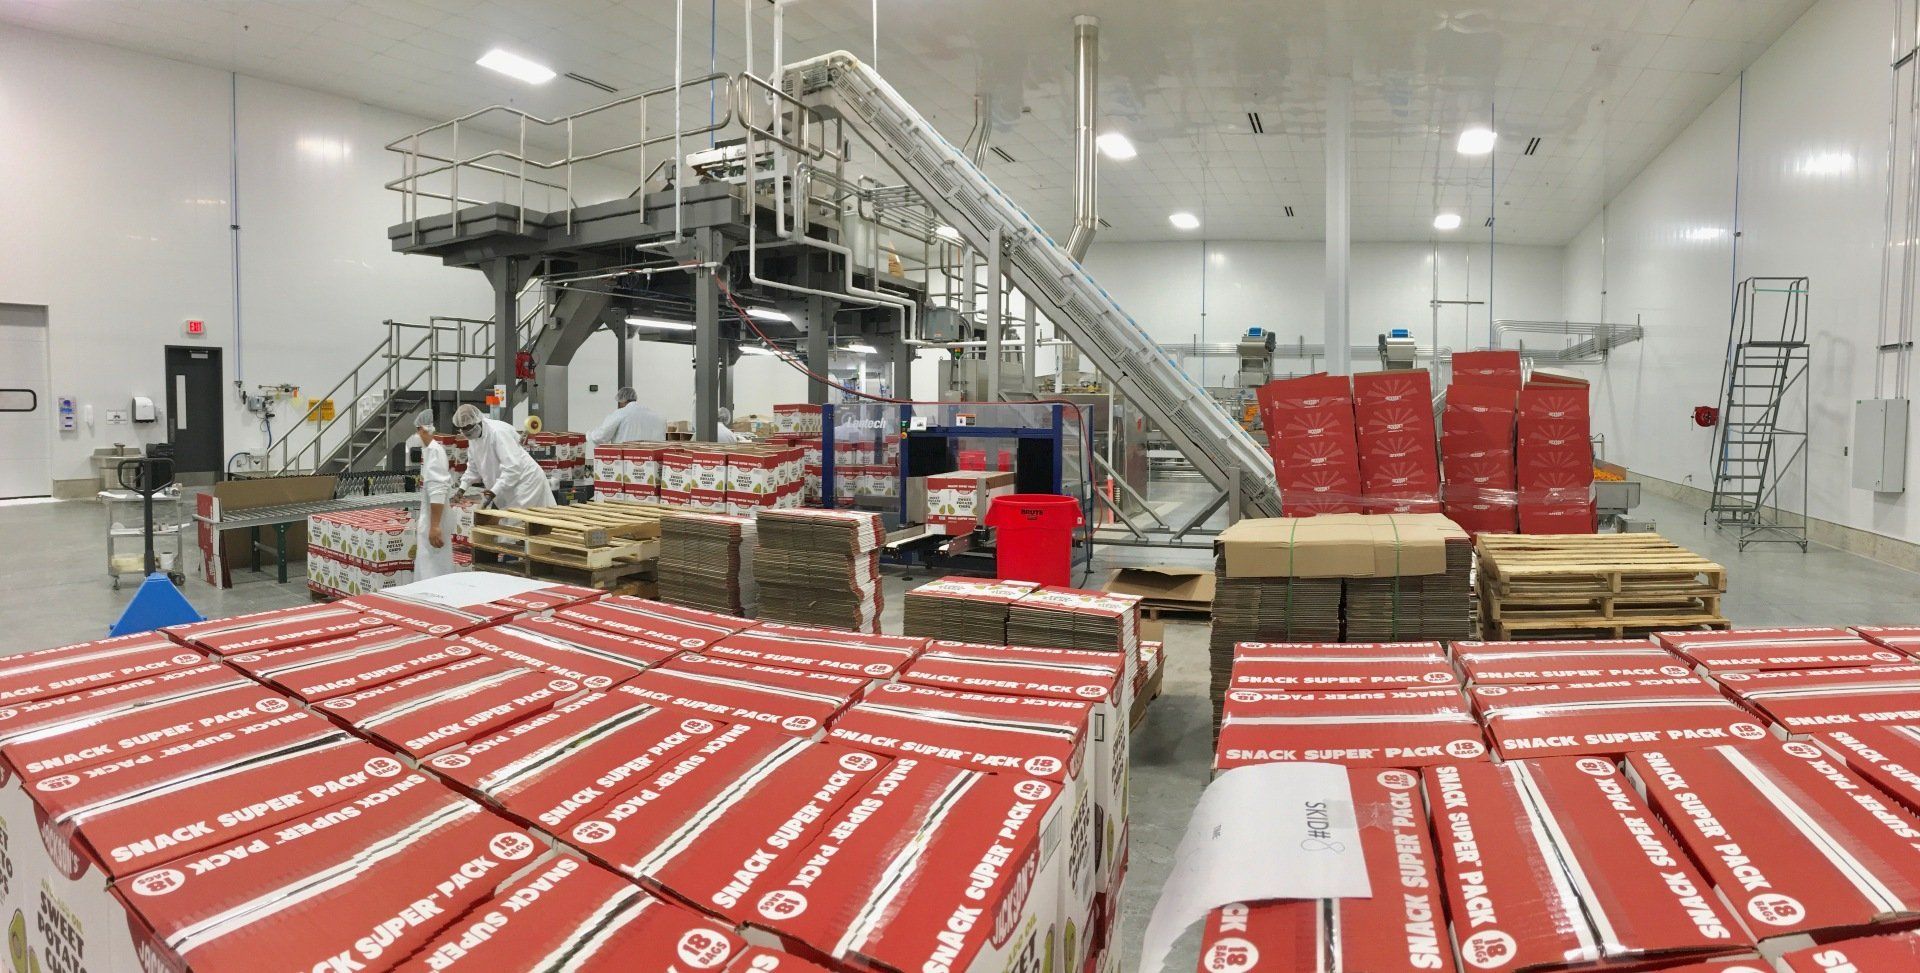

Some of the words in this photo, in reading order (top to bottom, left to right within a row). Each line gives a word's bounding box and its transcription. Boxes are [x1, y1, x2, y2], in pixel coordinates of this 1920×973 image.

[560, 610, 602, 623] SNACK
[645, 630, 682, 642] PACK
[121, 660, 171, 675] PACK
[460, 636, 502, 654] SNACK
[547, 665, 588, 680] PACK
[711, 646, 762, 658] SNACK
[818, 659, 862, 670] PACK
[1705, 658, 1766, 666] SNACK
[158, 665, 222, 681] SNACK
[300, 677, 358, 694] SNACK
[408, 652, 447, 666] PACK
[907, 671, 961, 682] SNACK
[1025, 683, 1072, 693] PACK
[1238, 676, 1298, 684] SNACK
[1371, 675, 1421, 683] PACK
[1475, 671, 1539, 679] SNACK
[23, 695, 82, 712] PACK
[556, 692, 608, 714] SNACK
[617, 685, 675, 702] SNACK
[732, 708, 783, 724] PACK
[1262, 693, 1320, 701] PACK
[1392, 690, 1457, 699] SNACK
[238, 712, 309, 734] SNACK
[405, 722, 469, 750] SNACK
[513, 688, 554, 706] PACK
[26, 744, 114, 773] SNACK
[199, 707, 257, 727] PACK
[465, 735, 511, 756] PACK
[699, 723, 751, 754] SNACK
[829, 728, 900, 748] SNACK
[971, 752, 1023, 768] PACK
[1454, 742, 1475, 750] 18
[1503, 735, 1580, 750] SNACK
[1666, 727, 1730, 740] PACK
[1828, 731, 1890, 764] SNACK
[367, 759, 391, 769] 18
[844, 755, 864, 767] 18
[857, 757, 874, 770] BAGS
[1226, 749, 1297, 761] SNACK
[1385, 745, 1445, 758] PACK
[82, 755, 154, 778] PACK
[375, 764, 399, 775] BAGS
[871, 758, 918, 797] SNACK
[1807, 760, 1860, 791] PACK
[539, 786, 604, 826] SNACK
[647, 732, 691, 763] PACK
[354, 774, 427, 808] SNACK
[1595, 778, 1636, 811] PACK
[110, 820, 215, 862] SNACK
[307, 771, 369, 798] PACK
[604, 789, 661, 822] PACK
[1389, 792, 1416, 828] PACK
[576, 822, 600, 835] BAGS
[1305, 801, 1331, 838] SKID#
[1642, 751, 1689, 791] SNACK
[1714, 844, 1772, 892] PACK
[494, 836, 518, 850] 18
[586, 828, 609, 839] 18
[712, 848, 778, 909] SNACK
[814, 769, 856, 802] PACK
[185, 839, 270, 876] PACK
[503, 841, 530, 858] BAGS
[1436, 766, 1468, 809] SNACK
[1459, 871, 1497, 928] PACK
[137, 870, 171, 886] BAGS
[436, 856, 499, 898] PACK
[788, 844, 840, 889] PACK
[146, 878, 176, 893] 18
[501, 859, 579, 912] SNACK
[922, 904, 984, 973] SNACK
[999, 801, 1036, 840] PACK
[760, 892, 785, 911] BAGS
[774, 899, 801, 914] 18
[1660, 872, 1731, 938] SNACK
[1753, 900, 1777, 922] BAGS
[1768, 899, 1797, 917] 18
[41, 891, 84, 958] SWEET
[1403, 892, 1443, 970] SNACK
[683, 933, 712, 956] 18
[698, 941, 728, 966] BAGS
[1471, 938, 1489, 963] BAGS
[1484, 938, 1507, 958] 18
[1213, 945, 1228, 970] BAGS
[1227, 946, 1248, 967] 18
